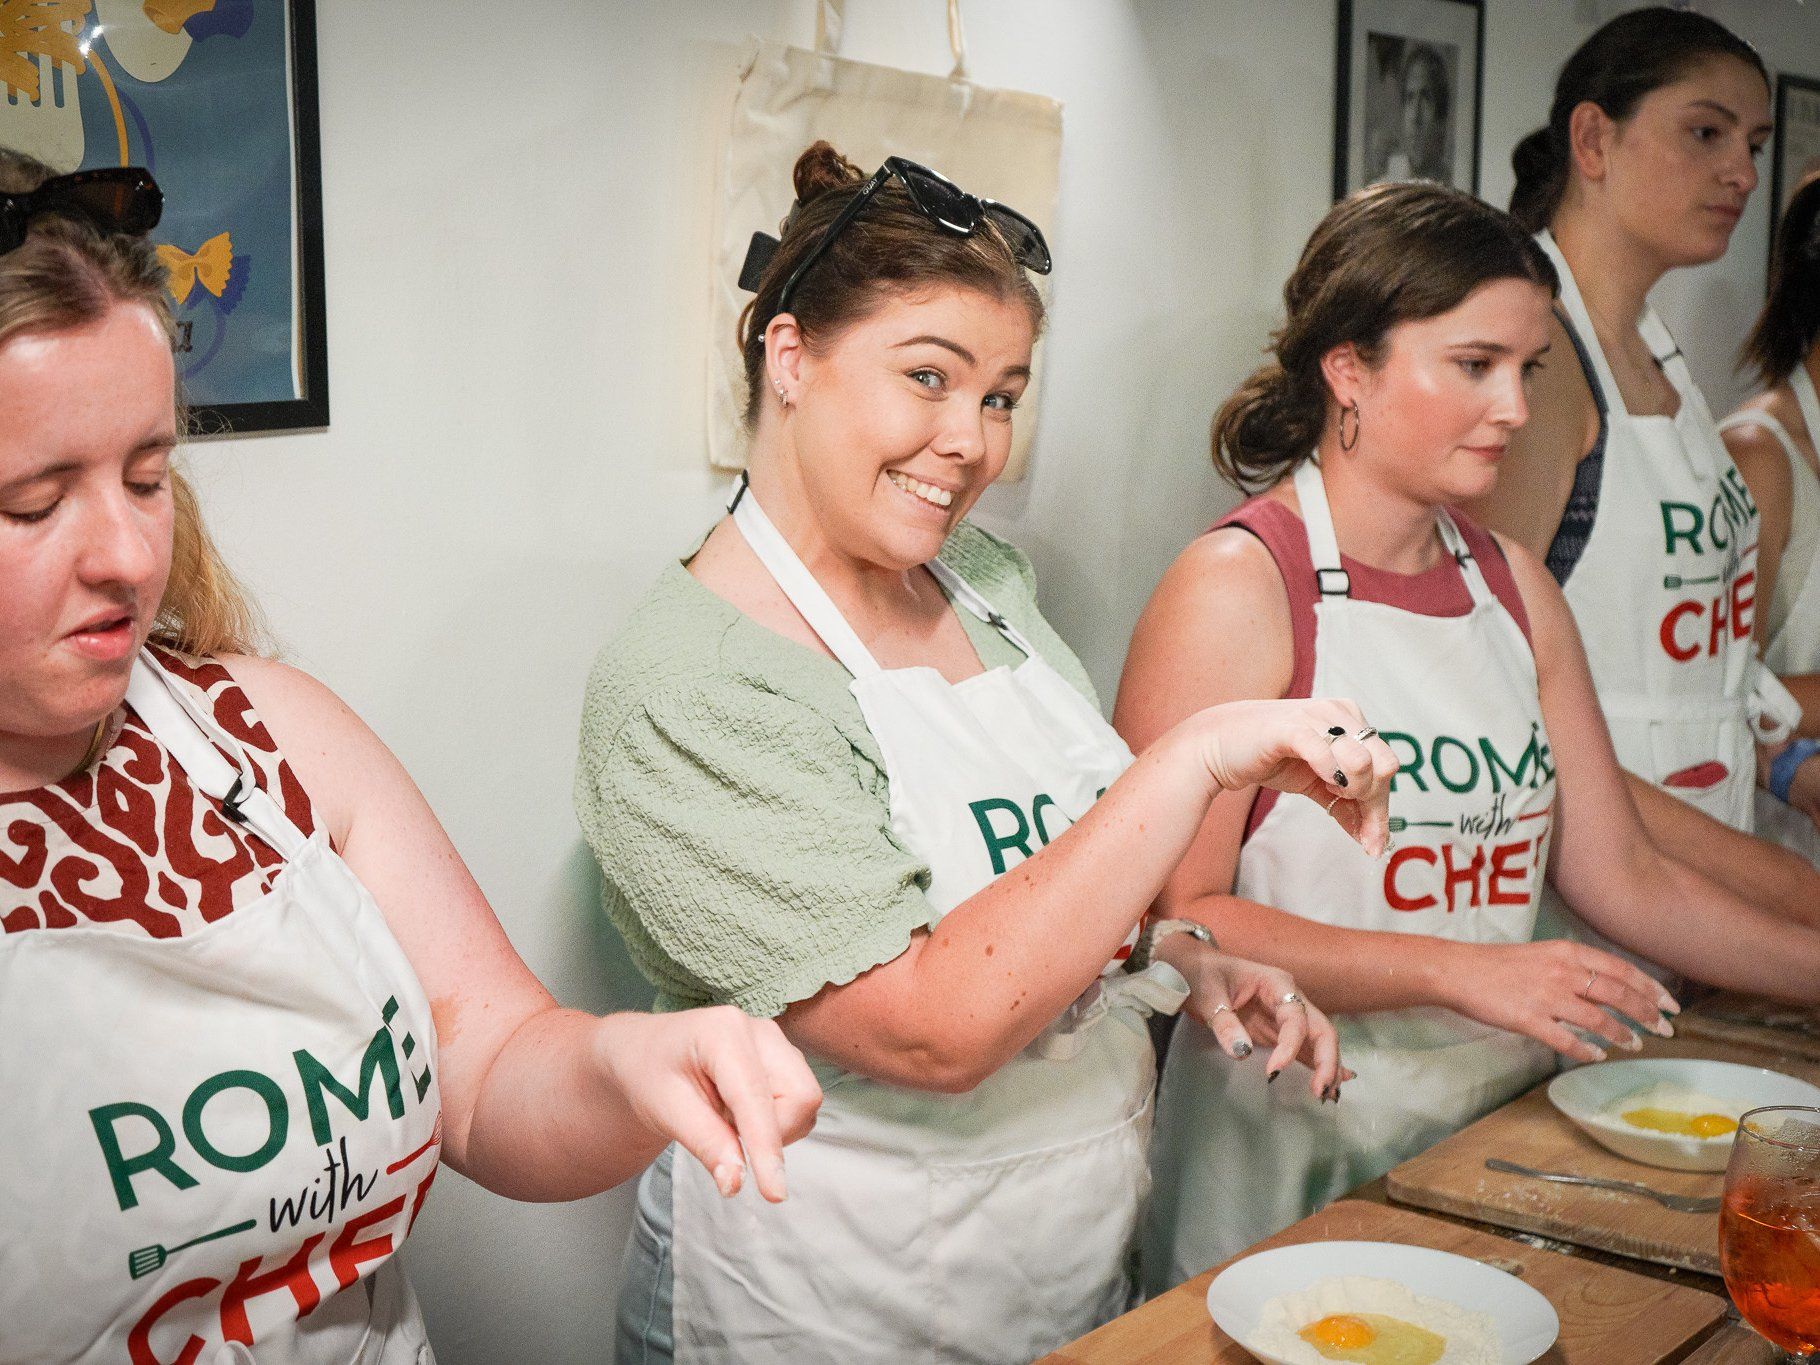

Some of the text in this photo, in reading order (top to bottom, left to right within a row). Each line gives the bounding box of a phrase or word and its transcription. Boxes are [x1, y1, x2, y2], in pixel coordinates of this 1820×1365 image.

[863, 177, 878, 195] QUAY
[1659, 570, 1755, 663] CHE
[1459, 793, 1515, 840] with
[269, 1136, 379, 1233] with
